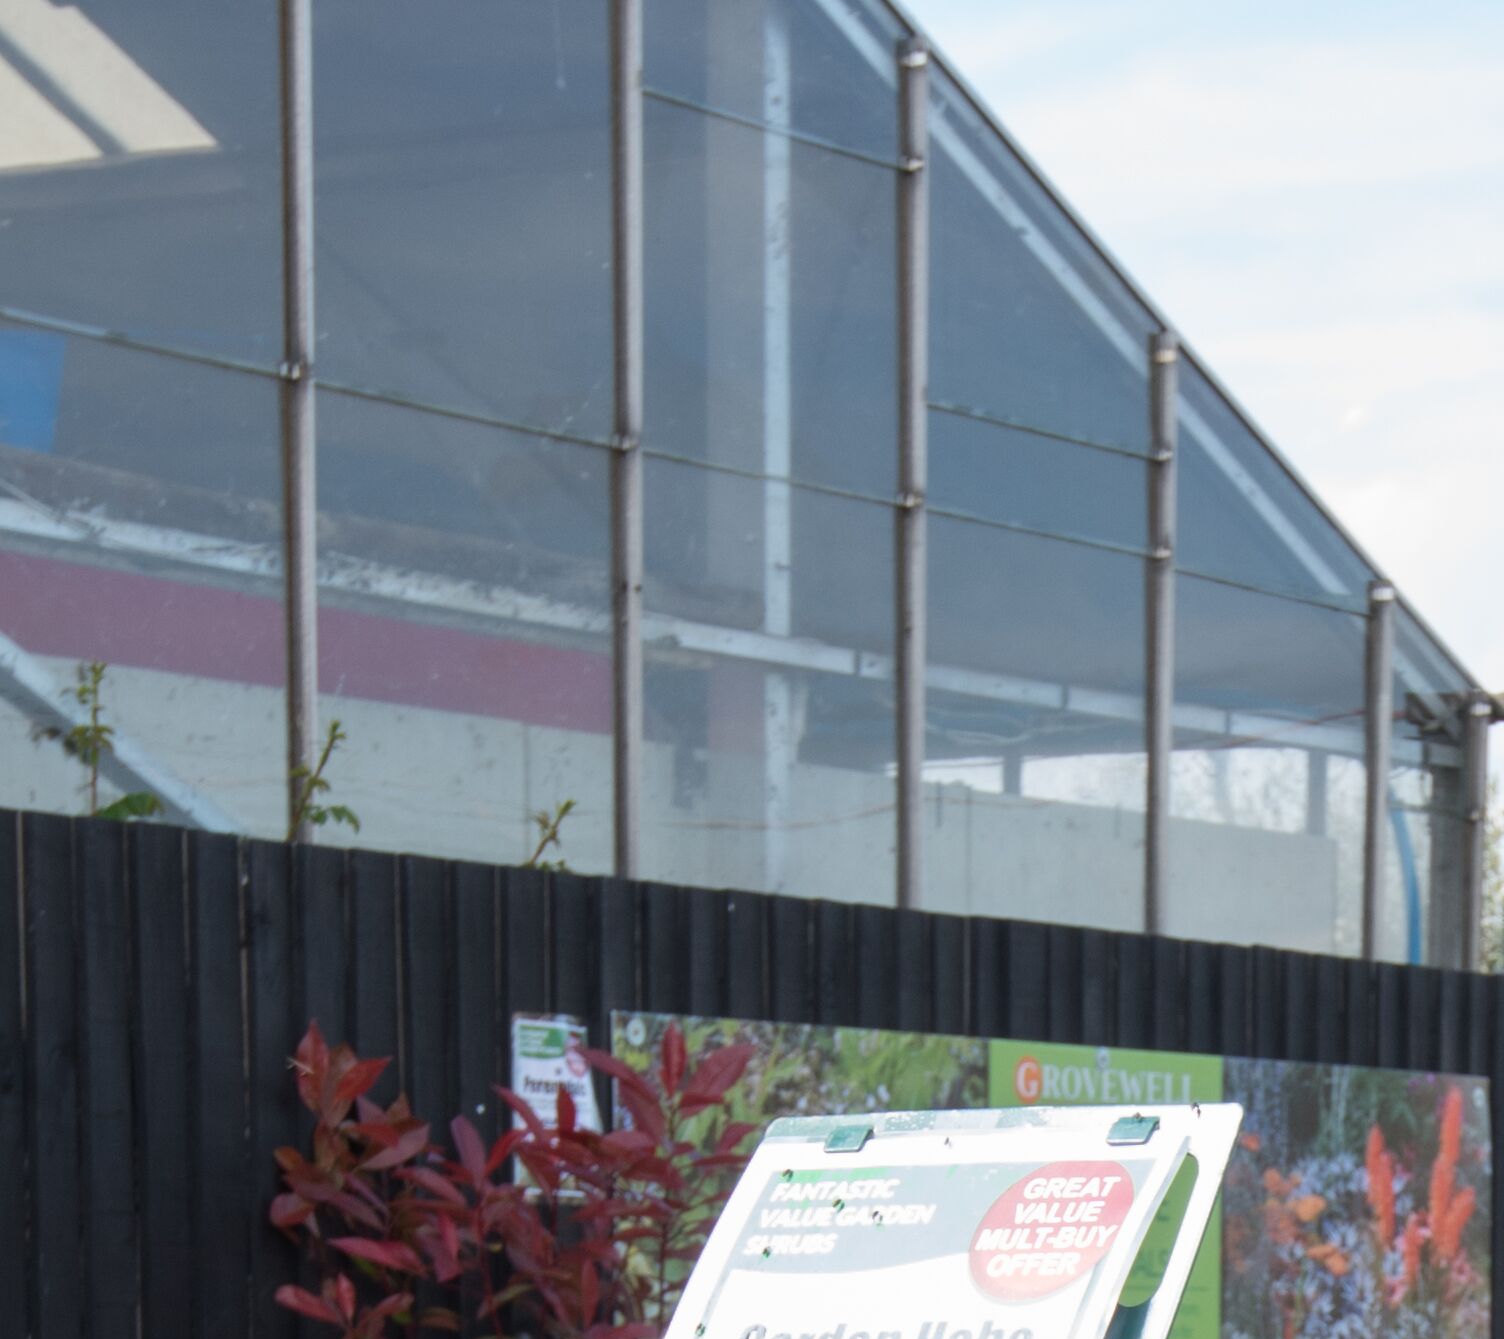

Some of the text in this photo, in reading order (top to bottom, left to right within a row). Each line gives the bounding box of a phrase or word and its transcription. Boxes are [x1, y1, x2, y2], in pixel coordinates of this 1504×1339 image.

[1015, 1060, 1192, 1104] GROVEWELL
[769, 1179, 901, 1202] FANTASTIC
[1023, 1176, 1121, 1199] GREAT
[759, 1204, 937, 1228] VALUE GARDEN
[1014, 1201, 1106, 1224] VALUE
[742, 1233, 839, 1256] SHRUBS
[975, 1225, 1118, 1251] MULT-BUY
[986, 1252, 1081, 1278] OFFER
